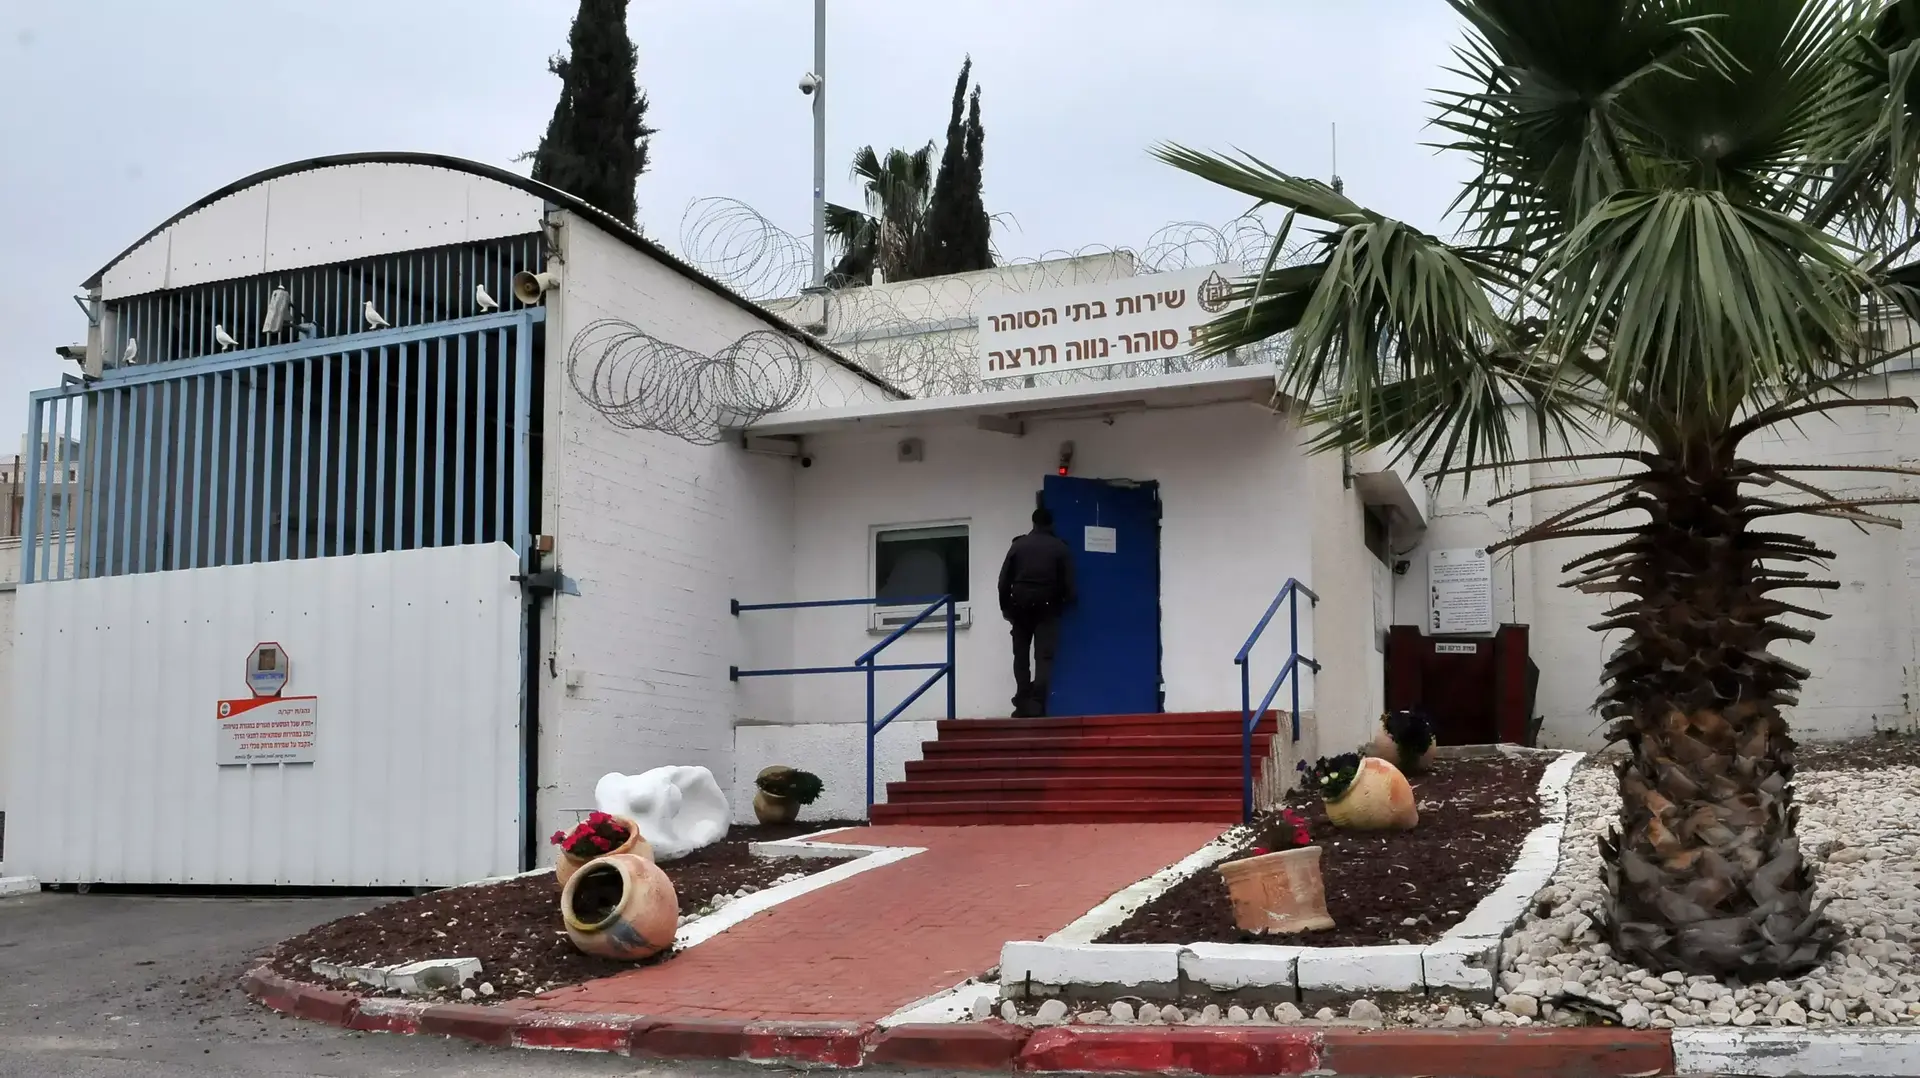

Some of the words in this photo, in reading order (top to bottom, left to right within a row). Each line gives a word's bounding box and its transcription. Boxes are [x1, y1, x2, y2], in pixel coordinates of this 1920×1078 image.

[1065, 301, 1107, 321] בתי
[1116, 289, 1186, 316] שירות
[987, 306, 1057, 333] הסוהר
[988, 344, 1057, 371] תרצה
